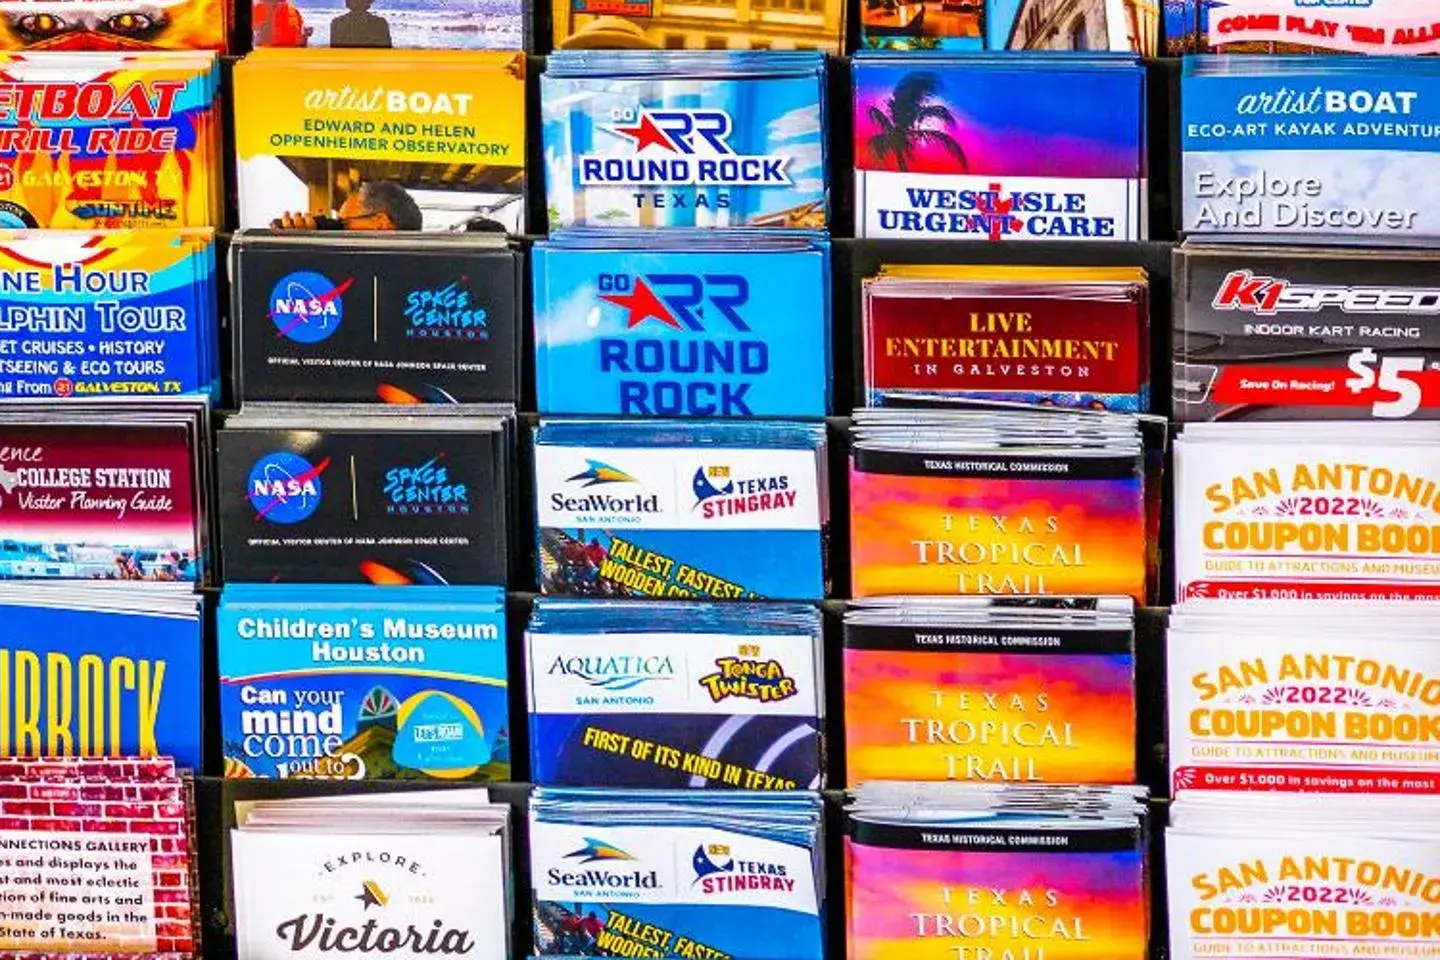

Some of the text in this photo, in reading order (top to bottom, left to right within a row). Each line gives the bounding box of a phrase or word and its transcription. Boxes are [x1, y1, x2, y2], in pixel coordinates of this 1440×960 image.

[303, 119, 476, 139] EDWARD AND HELEN
[87, 129, 178, 153] RIDE
[583, 158, 785, 183] ROUND ROCK
[633, 193, 731, 209] TEXAS
[907, 187, 1086, 214] WEST ISLE
[1196, 198, 1418, 228] And Discover
[413, 310, 487, 327] CENTER
[969, 313, 1032, 333] LIVE
[1243, 323, 1420, 338] INDOOR KART RACING
[21, 338, 84, 355] CRUISES
[98, 340, 165, 357] HISTORY
[600, 340, 768, 374] ROUND
[885, 340, 1118, 361] ENTERTAINMENT
[17, 469, 92, 489] COLLEGE
[95, 468, 172, 489] STATION
[253, 480, 317, 496] NASA
[551, 492, 660, 514] SeaWorld
[703, 491, 797, 519] STINGRAY
[1297, 497, 1360, 516] 2022
[942, 515, 1060, 533] TEXAS
[238, 618, 498, 640] Children's Museum
[311, 641, 424, 664] Houston
[548, 656, 674, 686] AQUATICA
[716, 658, 783, 678] TONGA
[241, 686, 344, 709] Can your
[931, 692, 1050, 711] TEXAS
[1286, 686, 1347, 704] 2022
[86, 841, 147, 852] GALLERY
[324, 851, 421, 875] EXPLORE
[738, 860, 787, 877] TEXAS
[547, 867, 658, 890] SeaWorld
[702, 873, 796, 895] STINGRAY
[940, 890, 1058, 906] TEXAS
[1288, 888, 1347, 904] 2022
